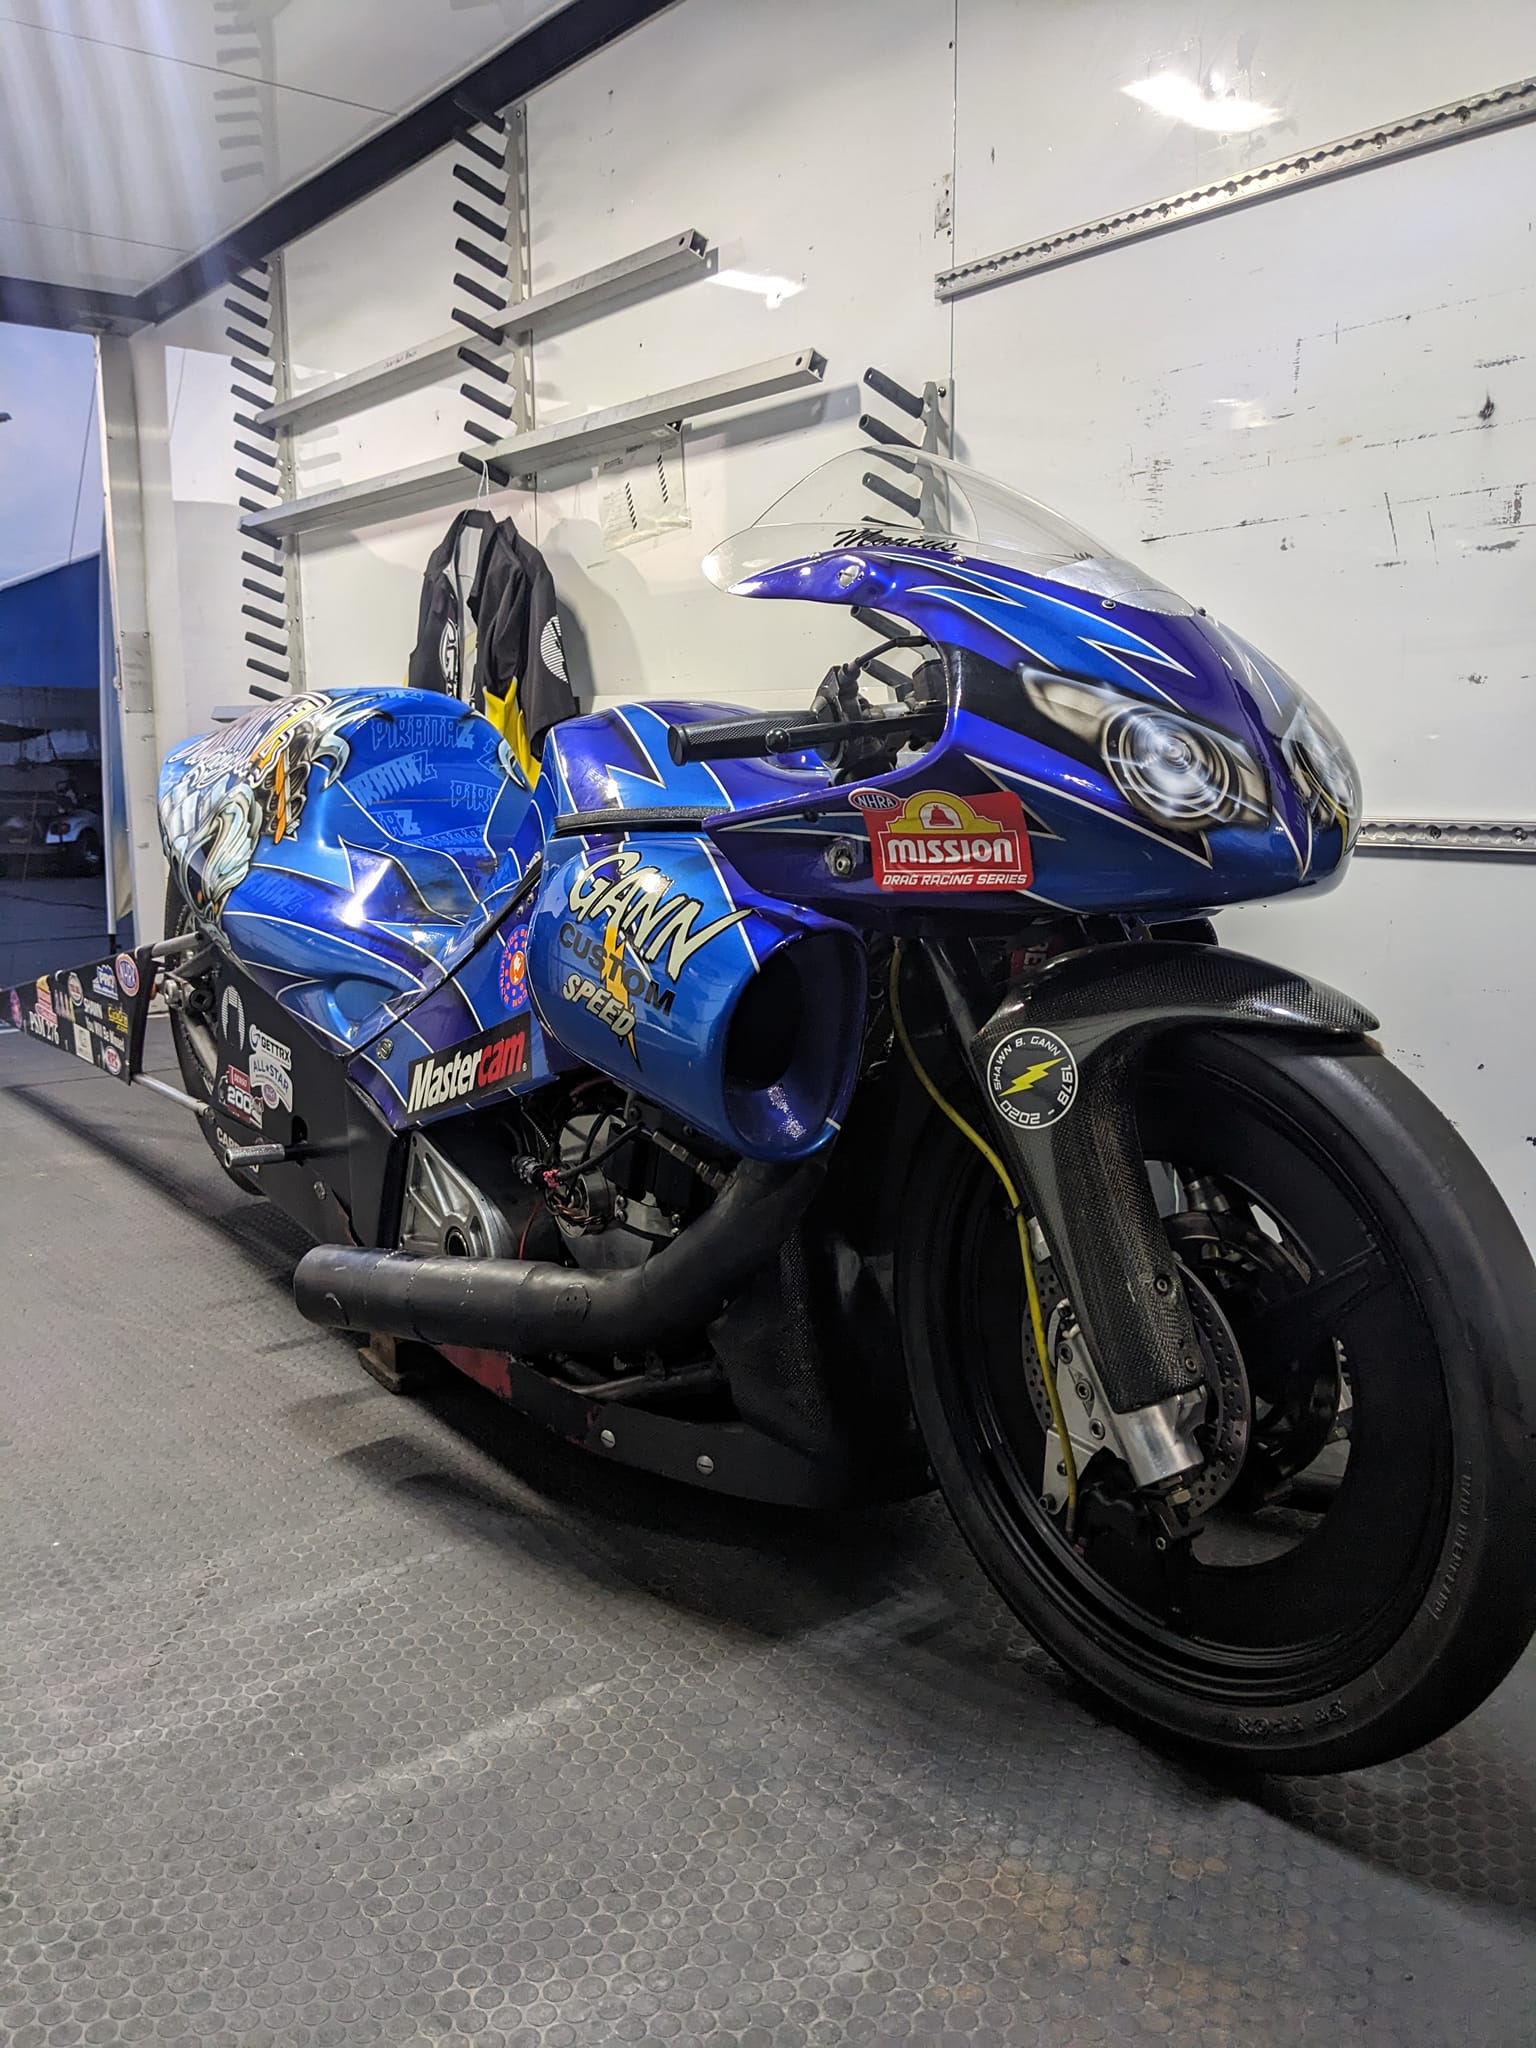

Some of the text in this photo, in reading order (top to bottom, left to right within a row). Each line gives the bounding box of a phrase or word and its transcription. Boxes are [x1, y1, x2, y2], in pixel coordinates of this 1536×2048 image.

[833, 529, 959, 552] Marcus
[856, 796, 897, 809] NHRA
[887, 838, 1013, 864] MISSION
[882, 874, 1028, 886] DRAG RACING SERIES
[568, 851, 754, 984] GANN
[560, 922, 677, 1017] CUSTOM
[562, 974, 636, 1037] SPEED
[261, 1036, 291, 1063] GETTRX
[993, 1035, 1062, 1091] SHAWN B. GANN
[407, 1031, 526, 1114] Mastercam
[1060, 1064, 1074, 1106] 1978
[999, 1099, 1041, 1125] 2020
